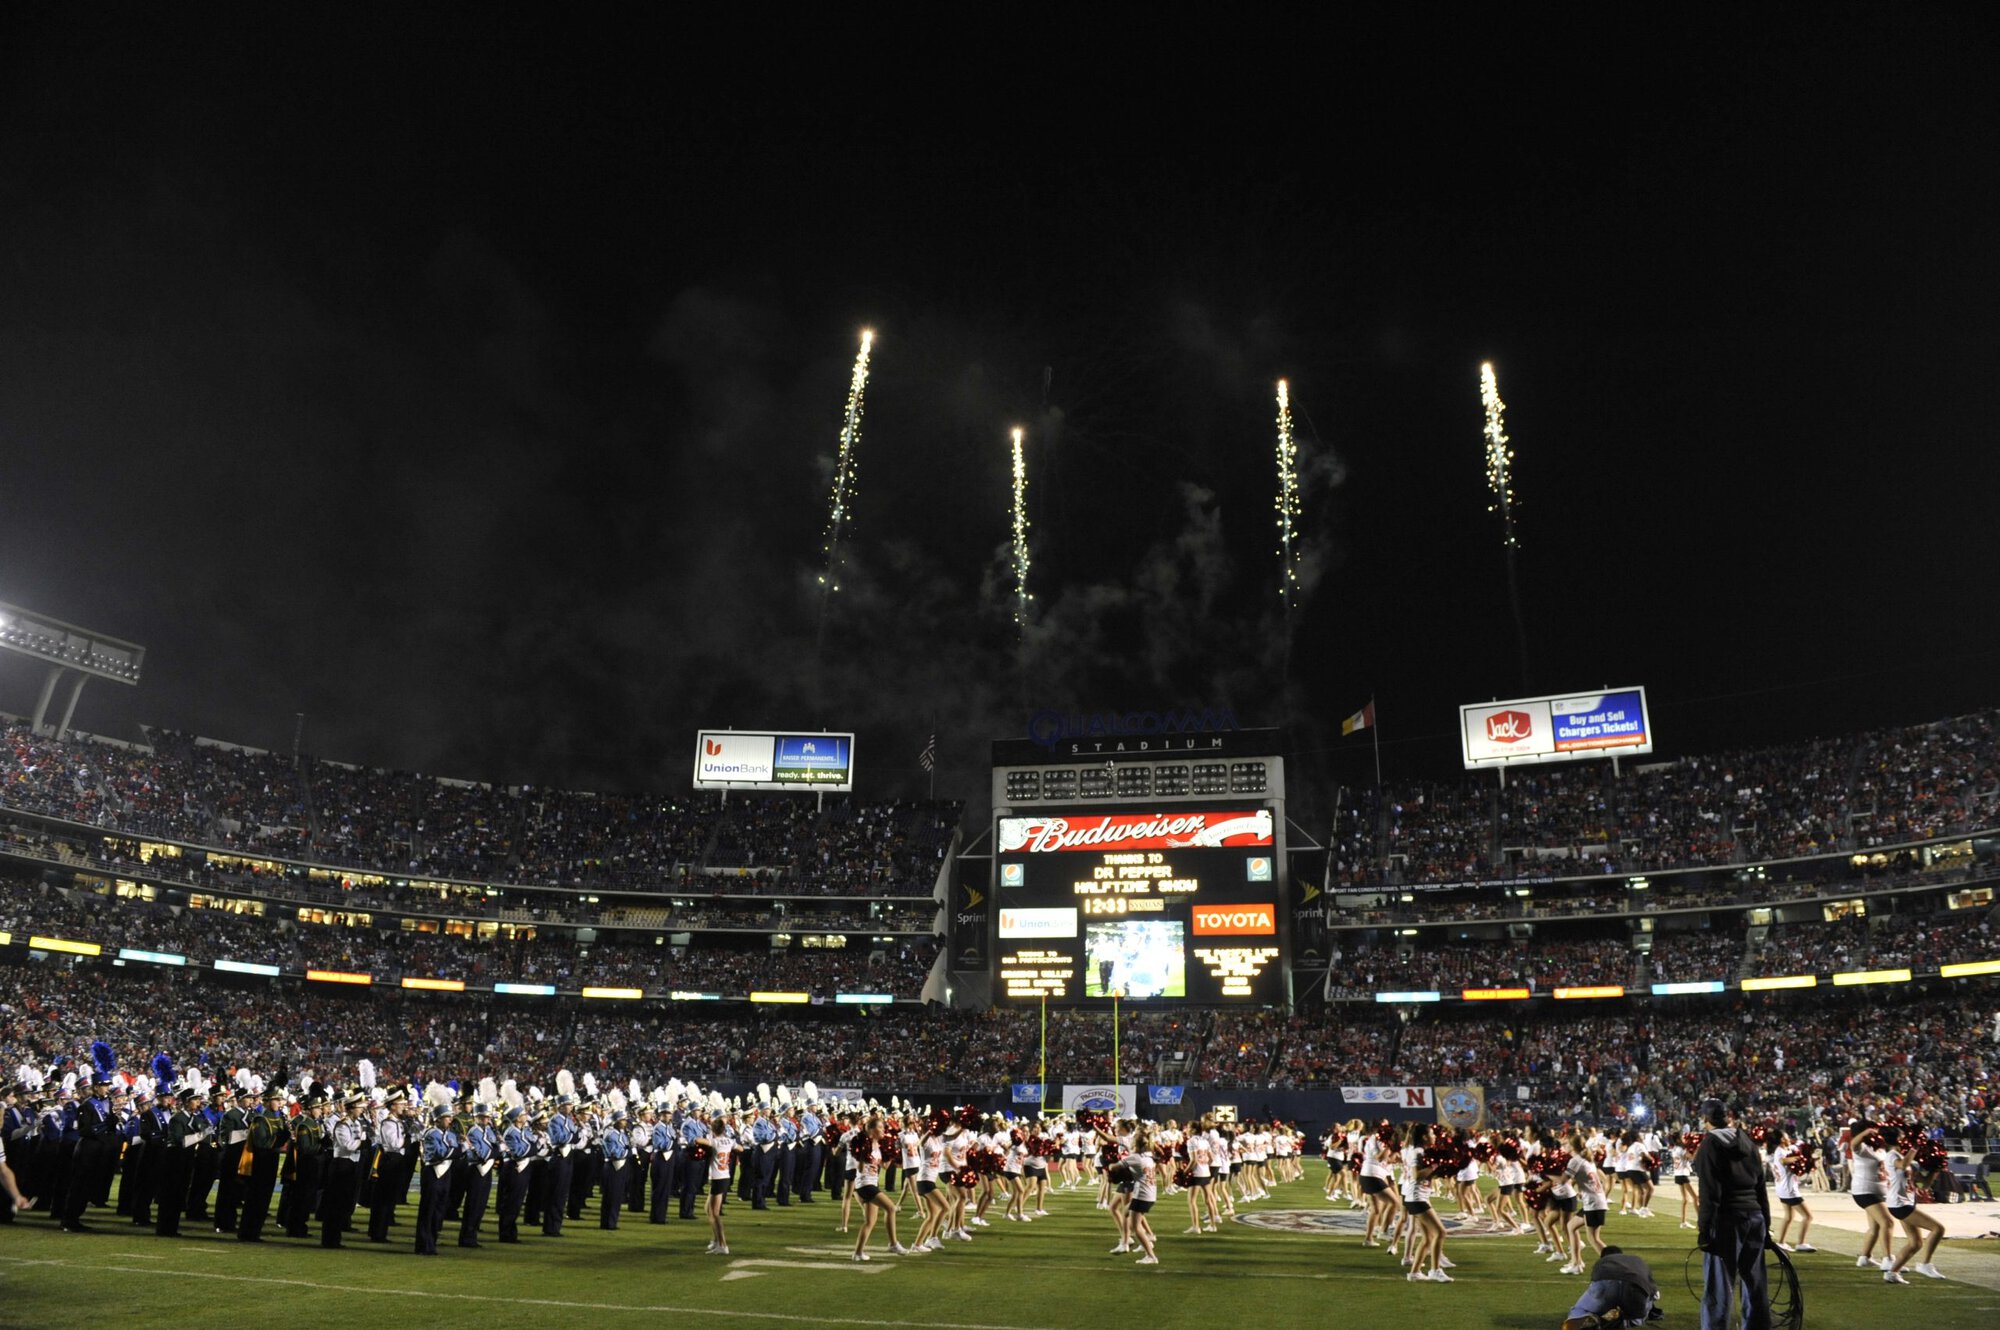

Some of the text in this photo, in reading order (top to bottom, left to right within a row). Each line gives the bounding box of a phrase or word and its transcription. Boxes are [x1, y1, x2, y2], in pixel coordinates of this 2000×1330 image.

[1569, 710, 1624, 725] Buy and Sell
[1027, 708, 1241, 752] QUALCOMM
[1489, 713, 1531, 740] Jack
[1559, 721, 1639, 738] Chargers Tickets!
[1072, 738, 1222, 752] STADIUM
[704, 764, 769, 774] UnionBank
[777, 771, 800, 780] ready.
[816, 772, 844, 780] thrive.
[1025, 814, 1206, 852] Budweiser
[1148, 853, 1163, 864] TO
[1094, 866, 1172, 879] DR PEPPER
[1074, 879, 1198, 894] HALFTIME SHOW
[957, 913, 986, 925] Sprint
[1196, 912, 1271, 929] TOYOTA
[1292, 908, 1325, 921] Sprint
[1020, 919, 1074, 929] UnionB
[1080, 1090, 1104, 1101] PACIFIC
[1406, 1089, 1425, 1106] N
[1215, 1105, 1235, 1122] 25
